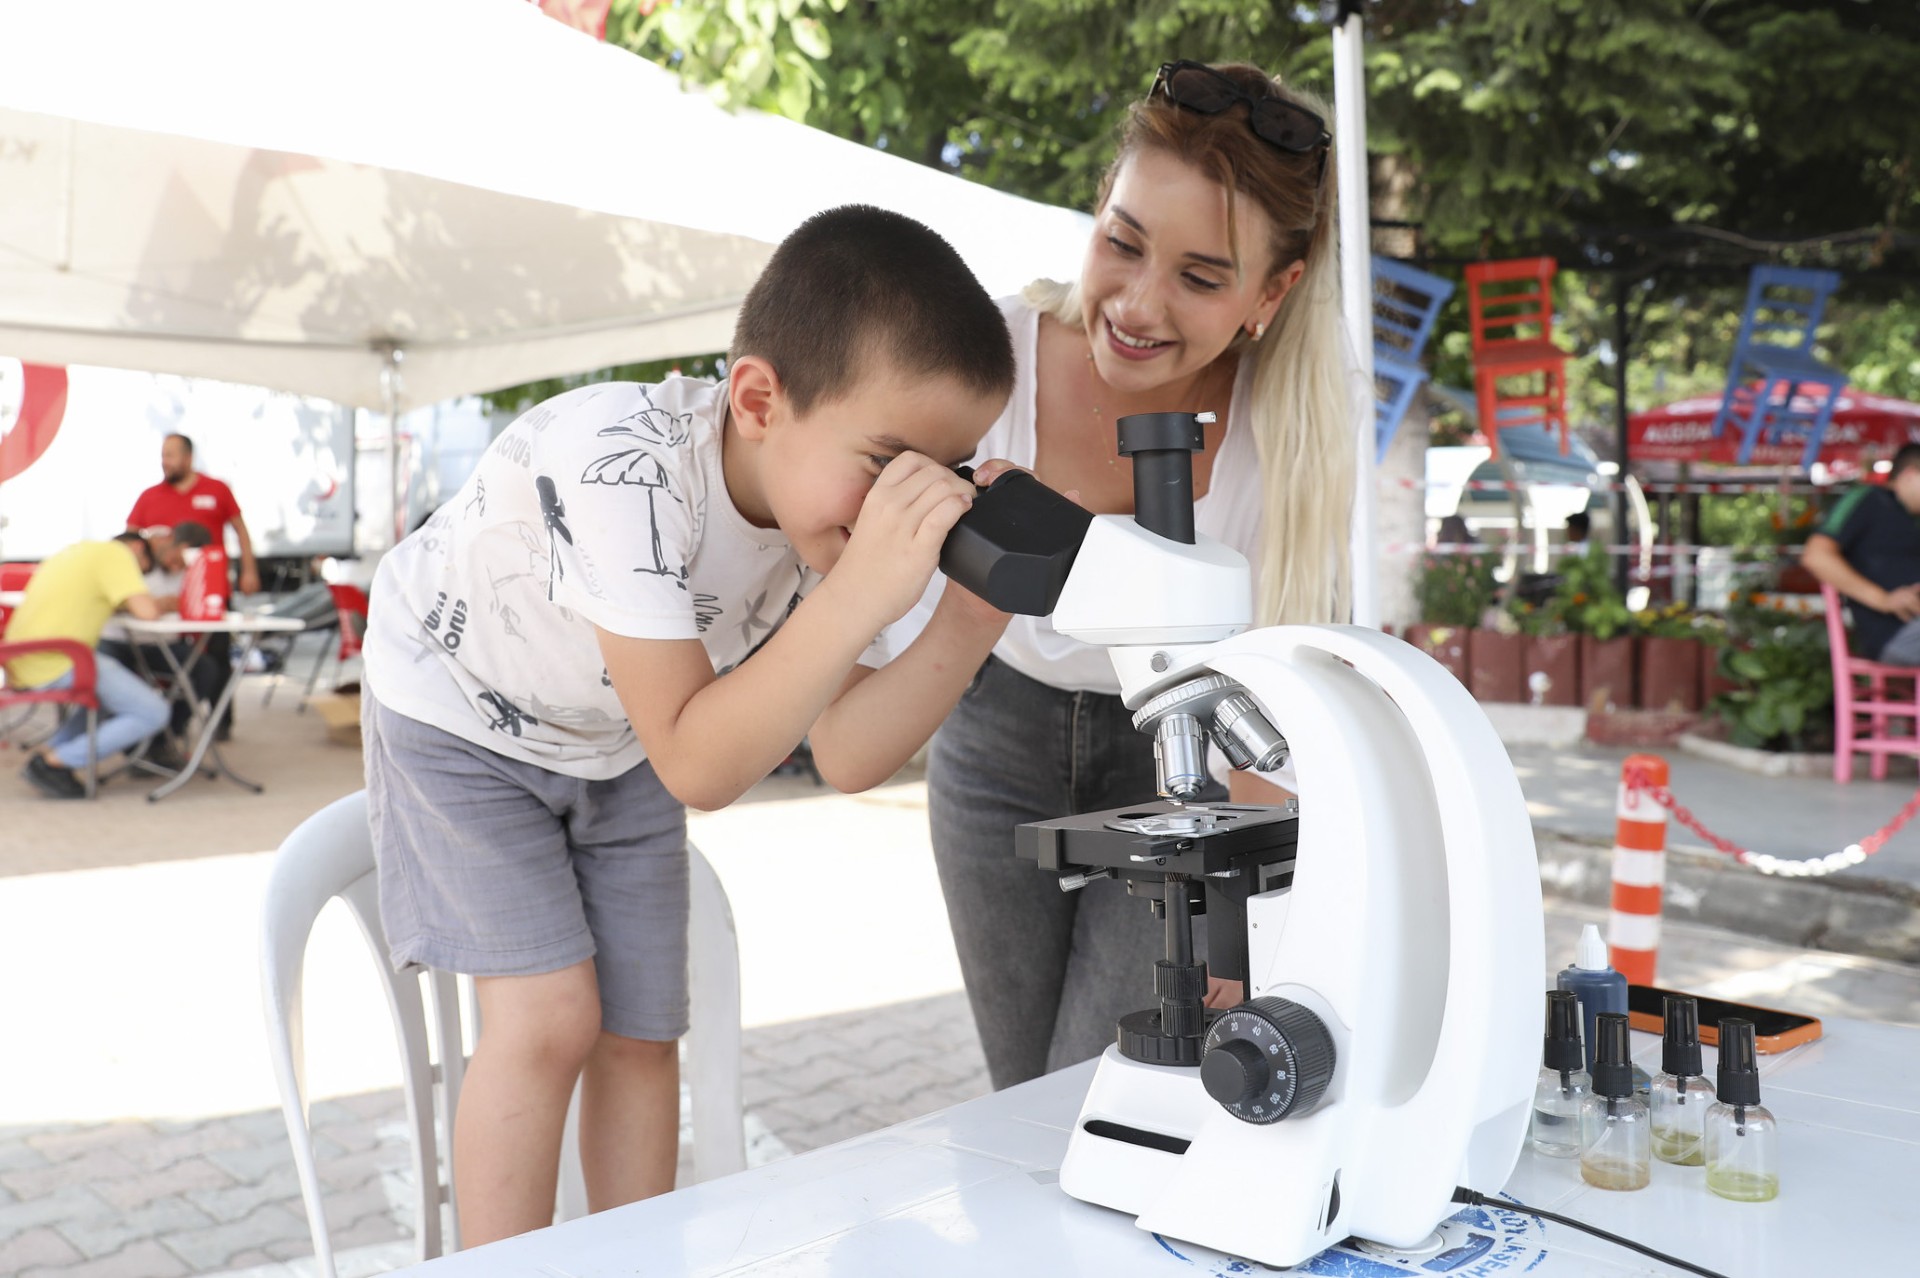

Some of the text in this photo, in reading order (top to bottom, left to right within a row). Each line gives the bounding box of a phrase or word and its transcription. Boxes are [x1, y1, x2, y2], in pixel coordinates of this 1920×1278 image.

[1231, 1022, 1238, 1031] 20
[1252, 1026, 1261, 1036] 40
[1269, 1044, 1279, 1054] 60
[1277, 1070, 1286, 1080] 80
[1270, 1092, 1281, 1104] 100
[1252, 1105, 1264, 1114] 120
